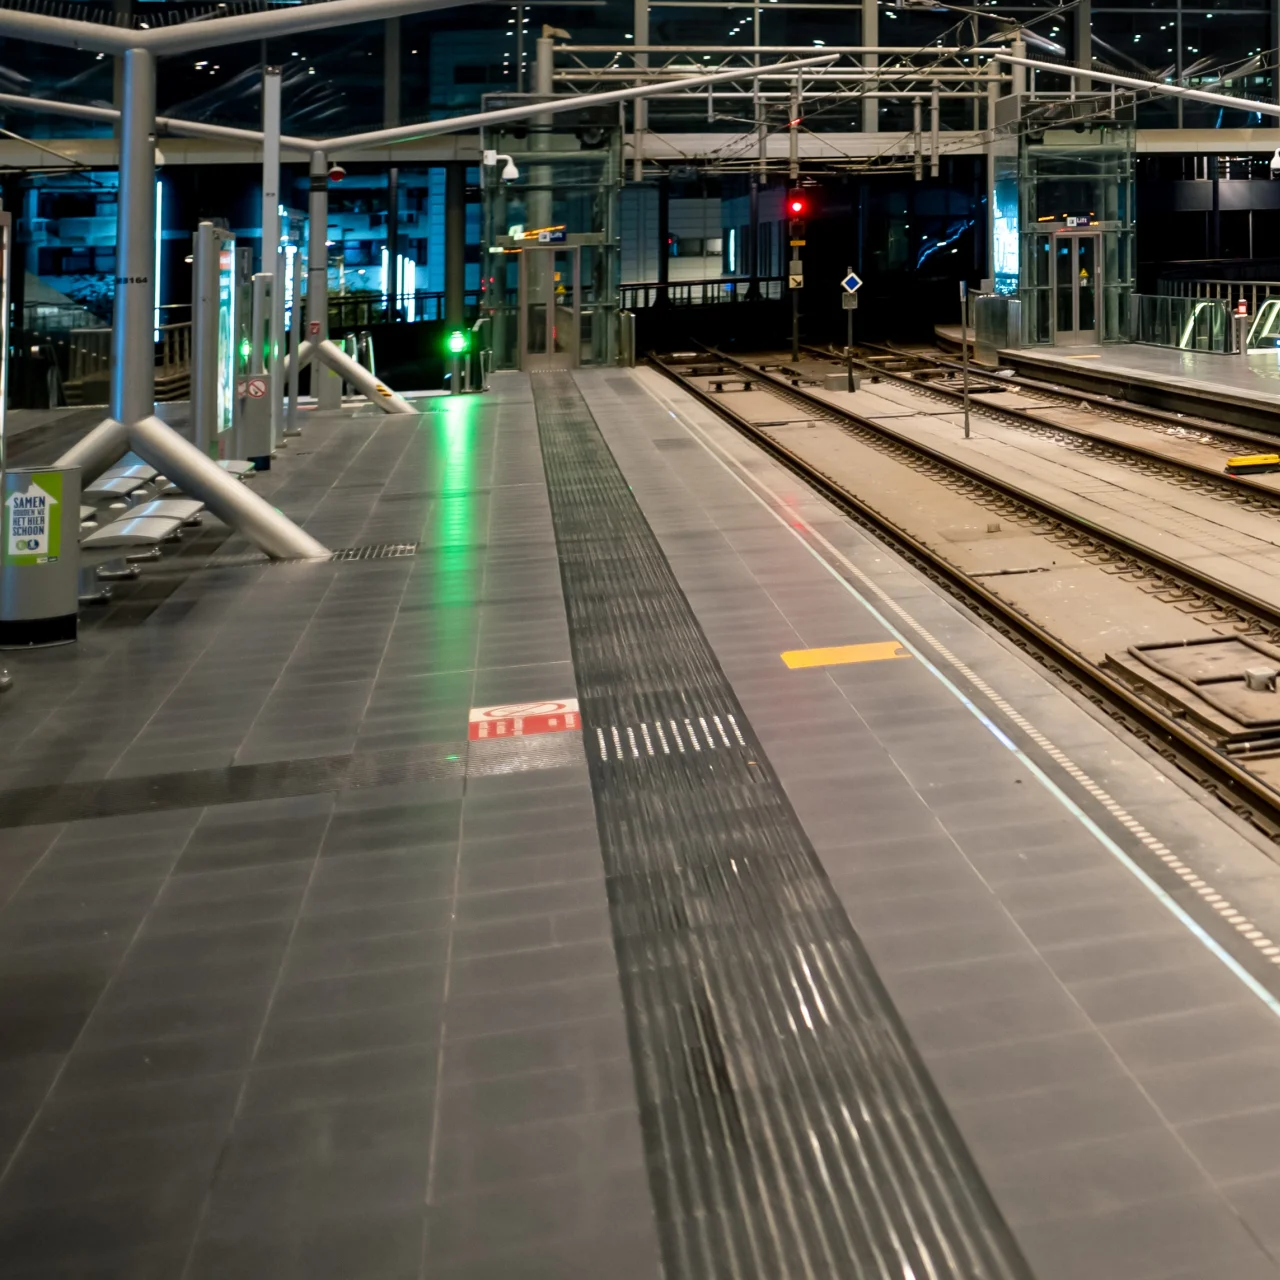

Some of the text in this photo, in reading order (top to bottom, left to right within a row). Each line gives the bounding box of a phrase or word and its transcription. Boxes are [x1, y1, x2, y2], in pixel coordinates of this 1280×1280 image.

[13, 496, 46, 509] SAMEN
[13, 508, 45, 516] HOUDEN WE
[13, 516, 45, 526] HET HIER
[13, 526, 44, 536] SCHOON
